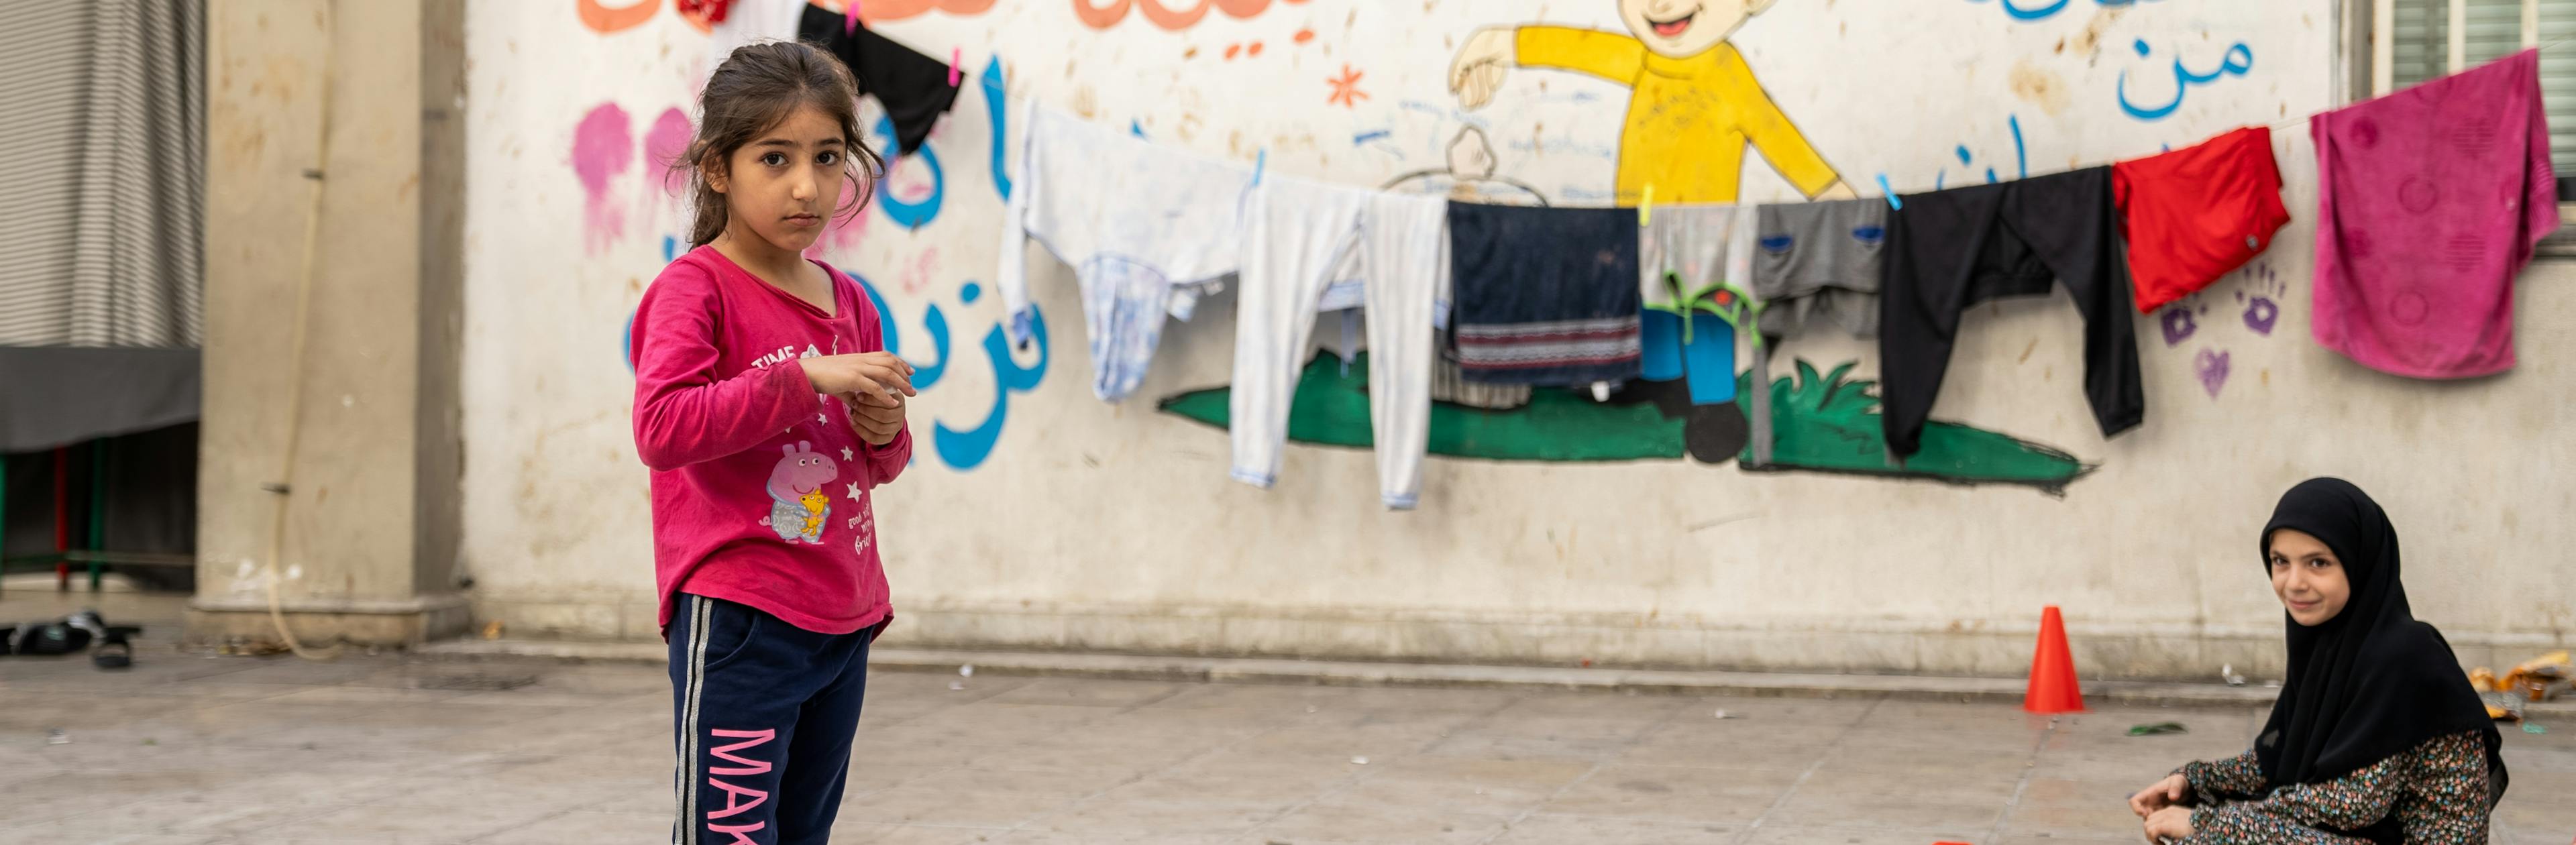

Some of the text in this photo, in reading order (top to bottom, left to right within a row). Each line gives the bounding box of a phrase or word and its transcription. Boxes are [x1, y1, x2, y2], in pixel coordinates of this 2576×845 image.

[2118, 38, 2253, 121] من
[751, 345, 794, 368] TIME
[848, 512, 862, 529] good
